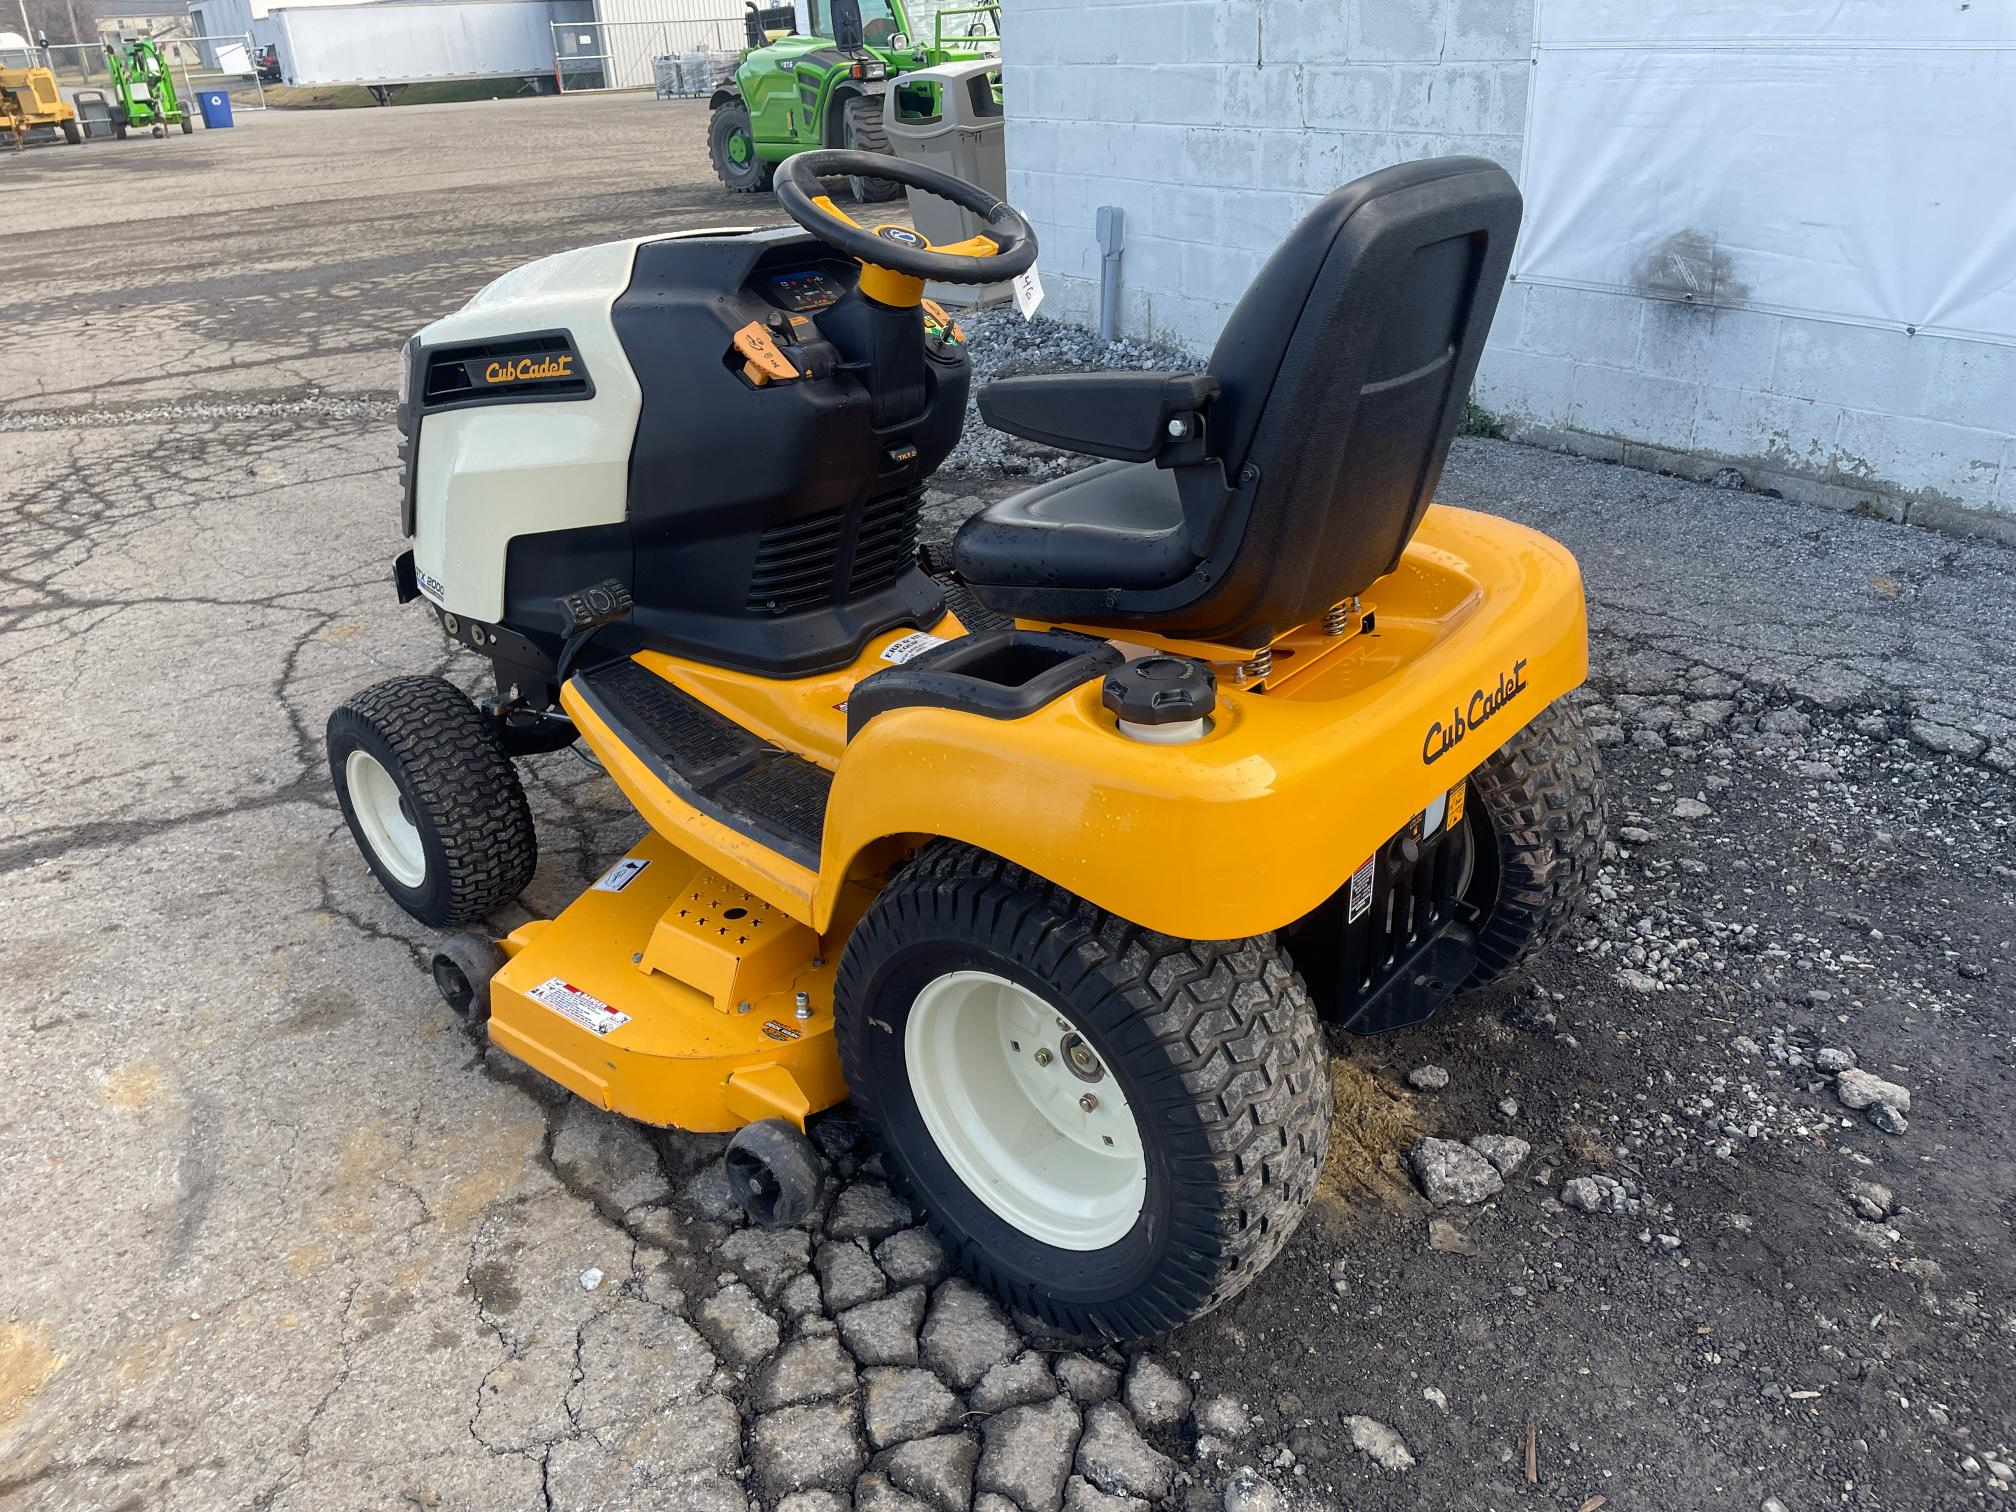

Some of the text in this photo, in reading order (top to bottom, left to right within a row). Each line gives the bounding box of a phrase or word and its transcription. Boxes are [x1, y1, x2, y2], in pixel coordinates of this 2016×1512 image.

[485, 355, 573, 383] Cub Cadet
[426, 576, 445, 596] 2000
[1422, 658, 1527, 765] Cub Cadet
